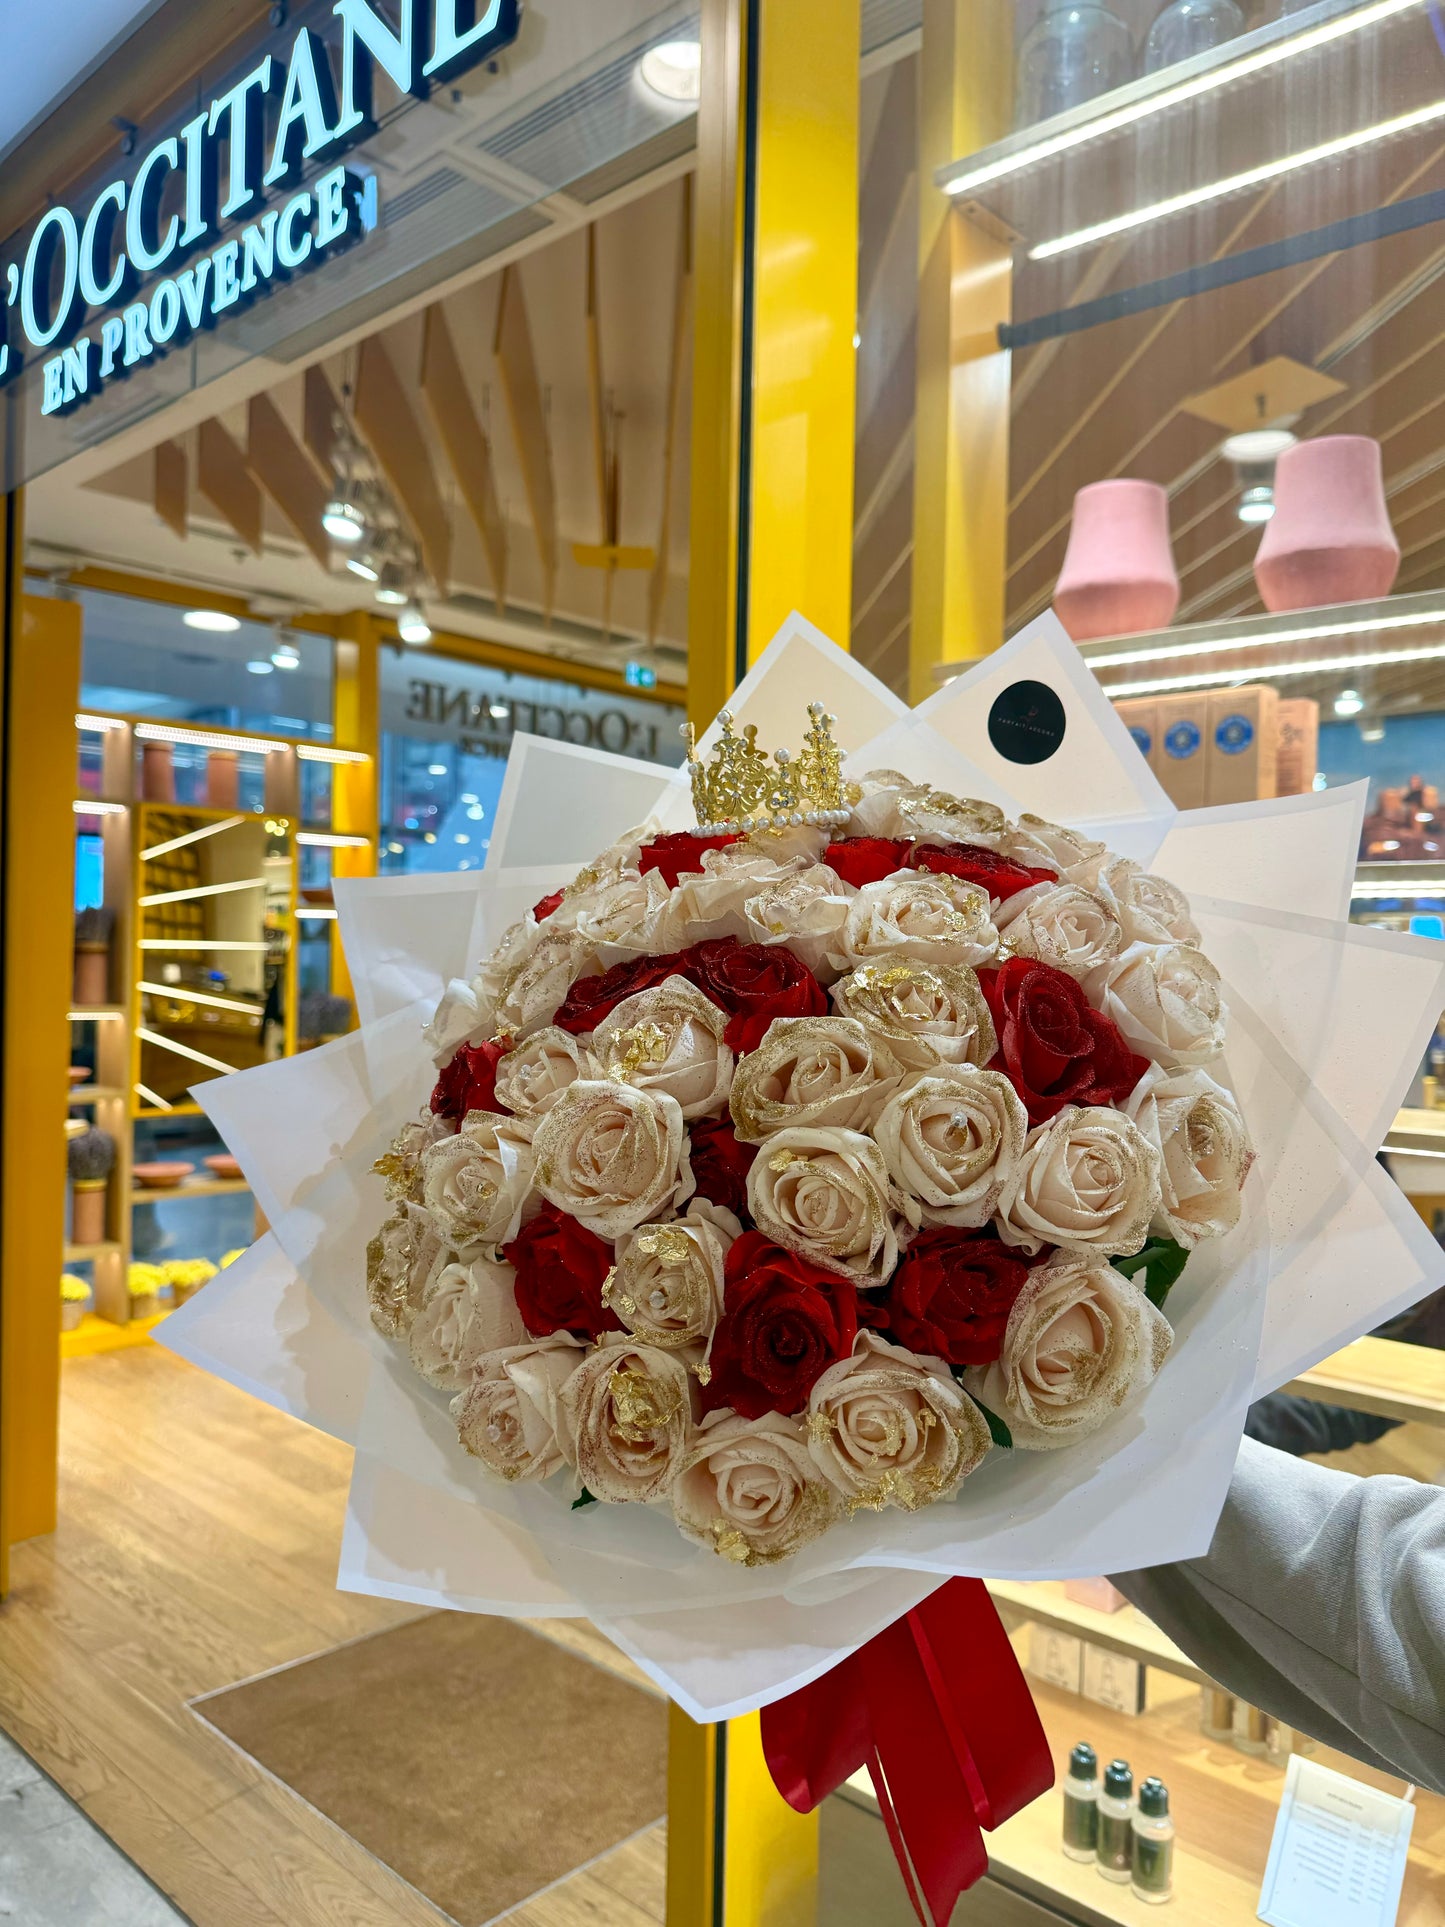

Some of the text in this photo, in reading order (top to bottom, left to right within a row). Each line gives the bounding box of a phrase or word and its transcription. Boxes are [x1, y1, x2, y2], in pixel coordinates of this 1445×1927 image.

[0, 0, 501, 375] 'OCCITAN
[42, 166, 347, 416] EN PROVENCE
